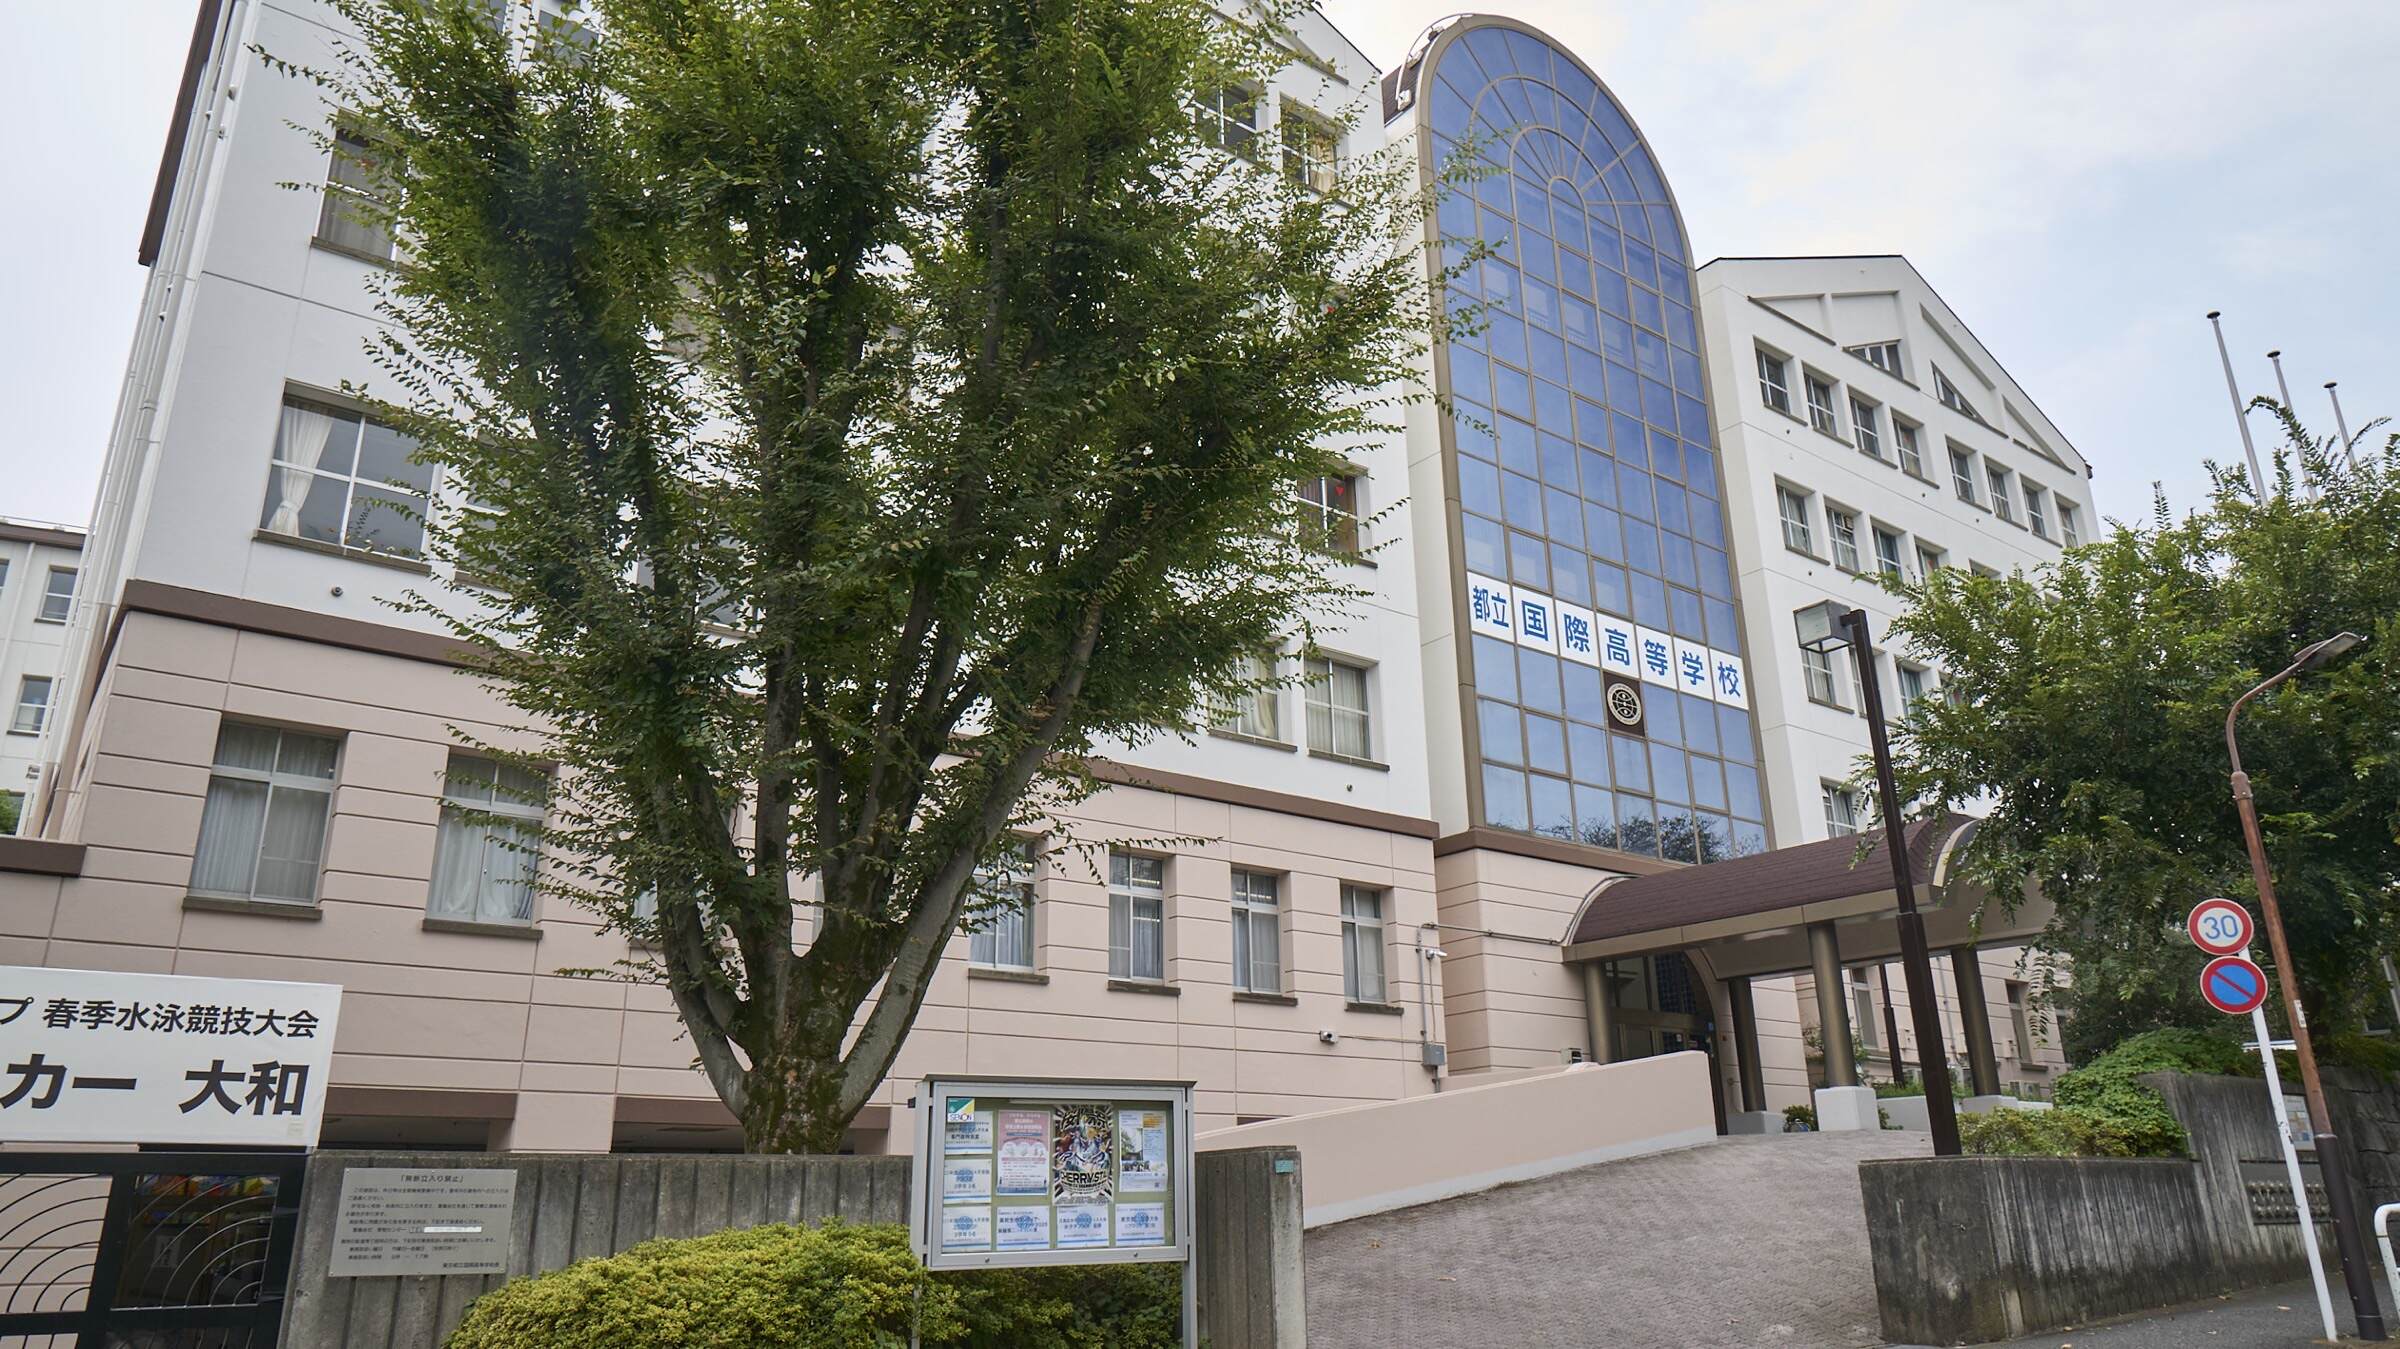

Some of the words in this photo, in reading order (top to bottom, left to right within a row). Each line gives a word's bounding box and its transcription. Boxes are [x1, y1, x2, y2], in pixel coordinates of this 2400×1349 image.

[1472, 585, 1741, 697] 都立国際高等学校
[2204, 916, 2239, 939] 30
[42, 998, 319, 1039] 春季水泳競技大会
[0, 1053, 137, 1110] カー
[179, 1059, 310, 1116] 大和
